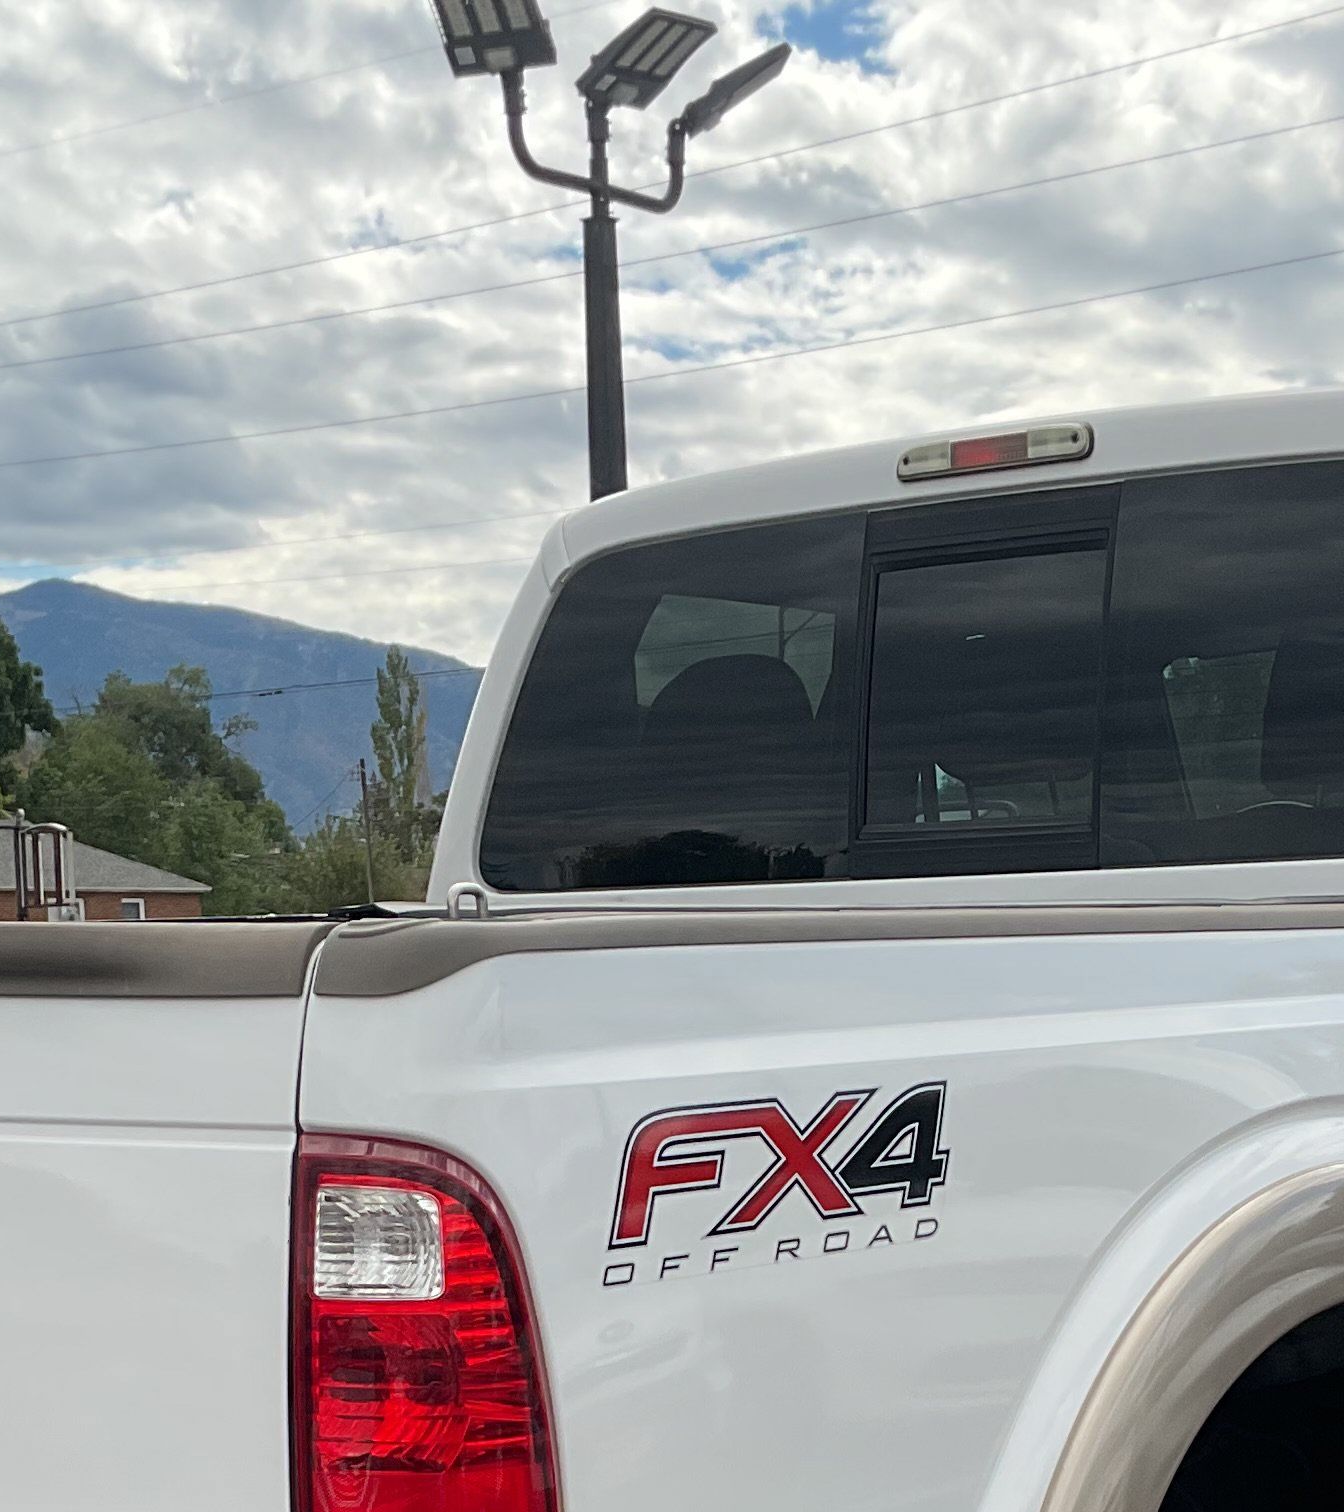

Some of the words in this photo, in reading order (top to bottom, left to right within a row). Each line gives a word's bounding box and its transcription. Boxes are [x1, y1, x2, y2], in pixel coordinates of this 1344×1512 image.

[607, 1080, 950, 1250] FX4
[602, 1247, 739, 1287] OFF
[775, 1218, 939, 1261] ROAD
